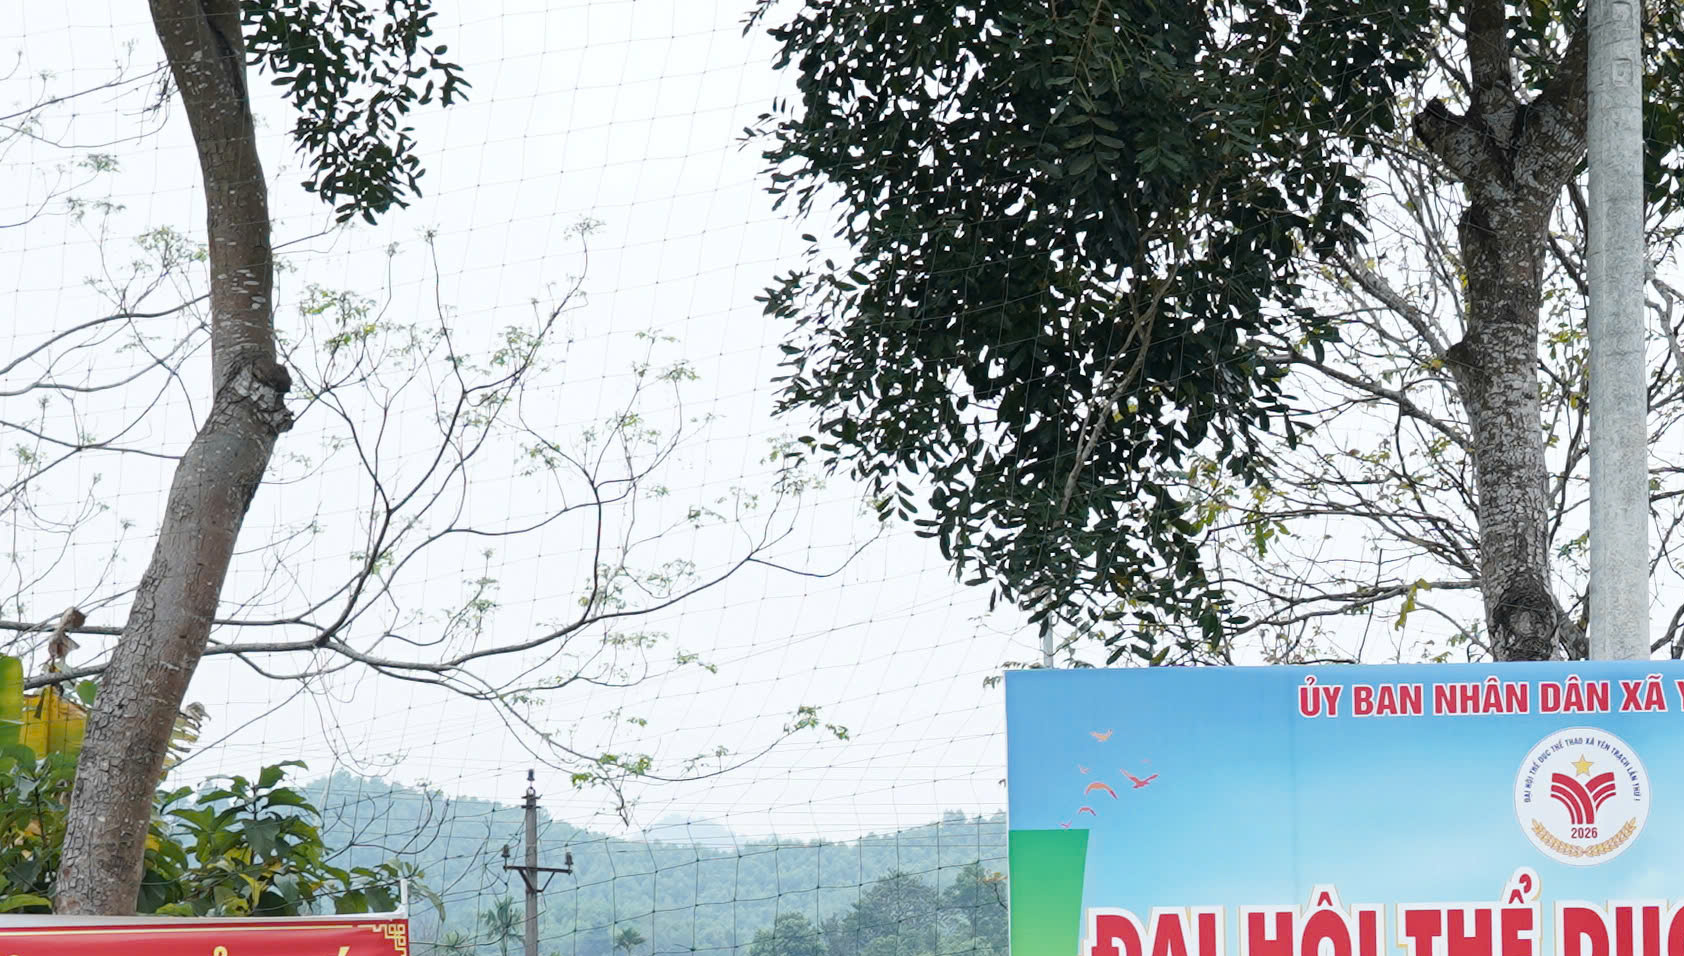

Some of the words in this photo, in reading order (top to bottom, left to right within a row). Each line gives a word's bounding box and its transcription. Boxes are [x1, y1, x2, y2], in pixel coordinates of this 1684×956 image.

[1300, 675, 1341, 716] ỦY
[1354, 685, 1422, 715] BAN
[1434, 676, 1529, 714] NHÂN
[1541, 675, 1609, 713] DÂN
[1621, 675, 1666, 711] XÃ
[1570, 827, 1598, 839] 2026
